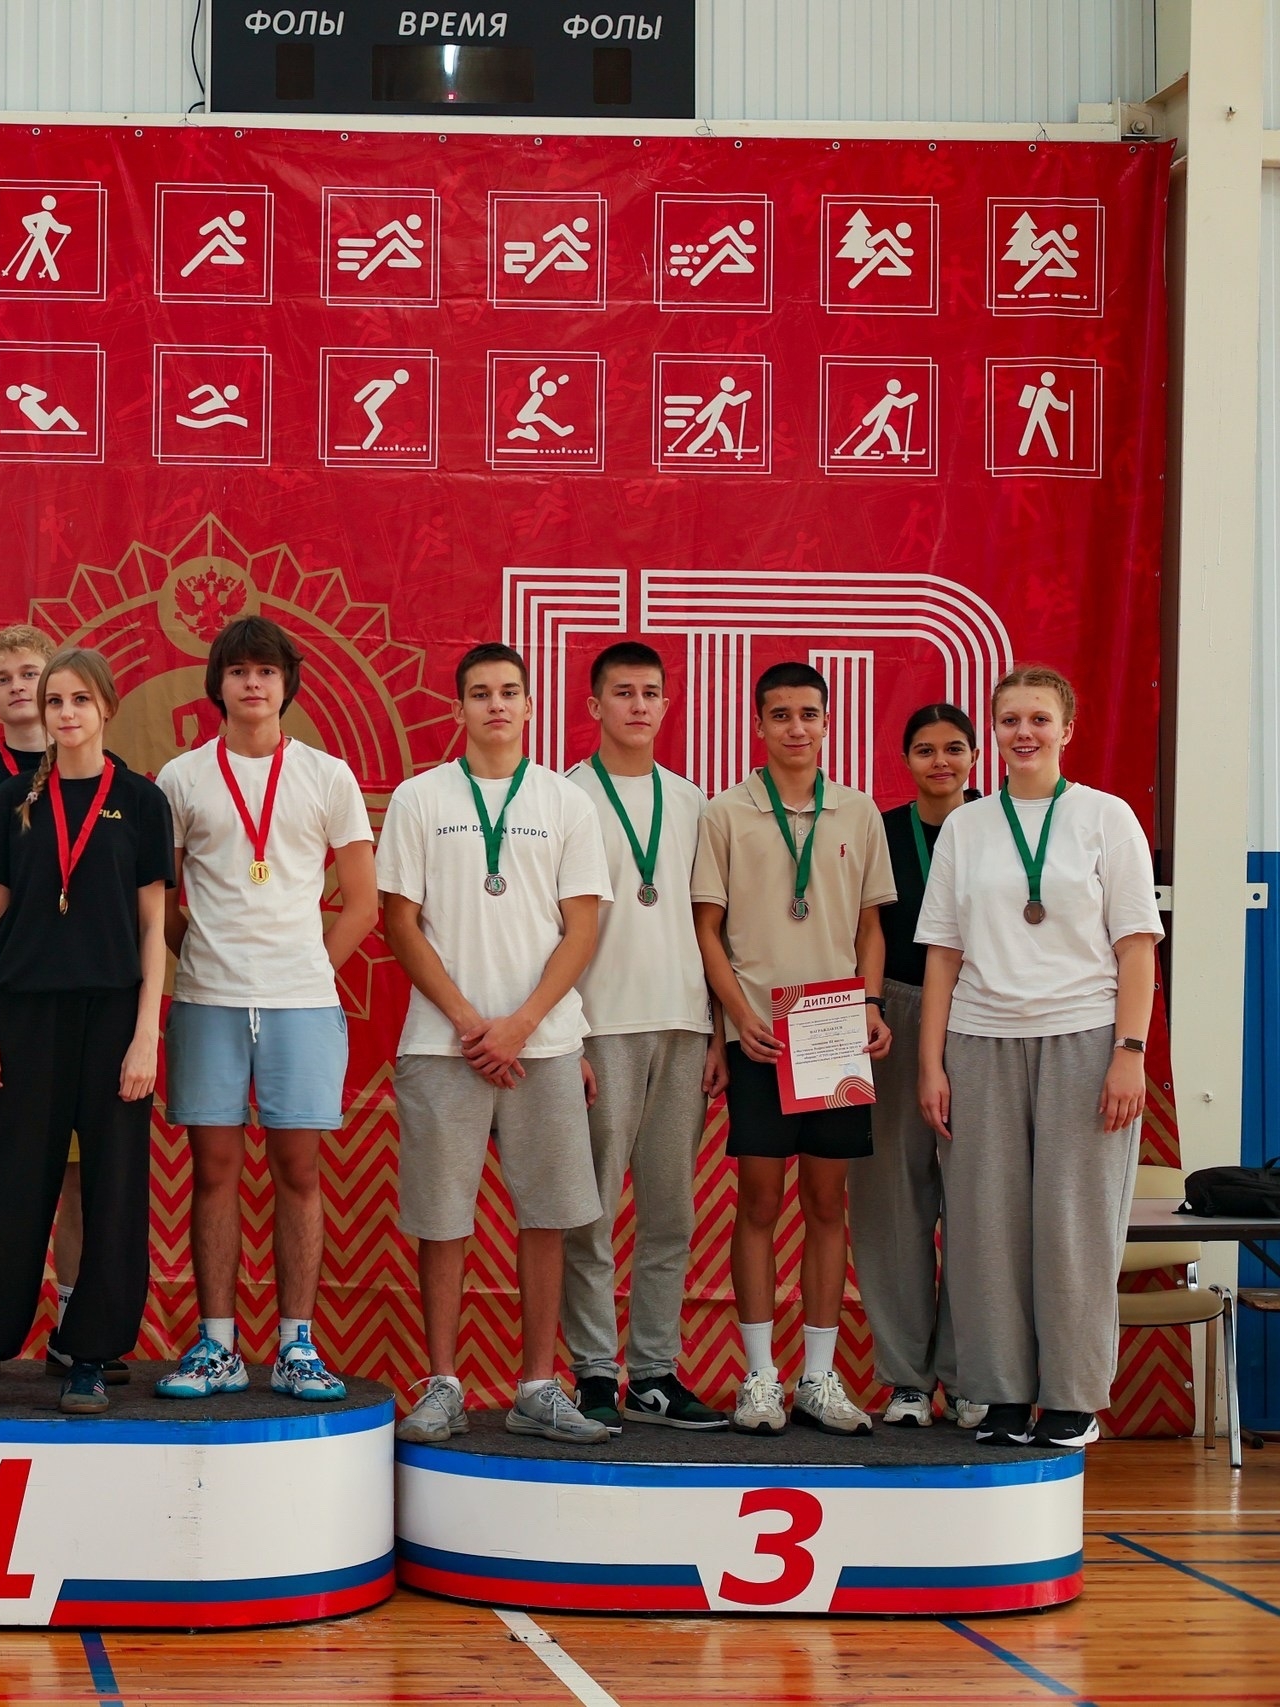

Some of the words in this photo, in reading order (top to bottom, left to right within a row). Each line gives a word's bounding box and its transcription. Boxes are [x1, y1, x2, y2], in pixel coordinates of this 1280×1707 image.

[244, 10, 346, 36] ФОЛЫ
[398, 12, 509, 38] ВРЕМЯ
[562, 14, 664, 40] ФОЛЫ
[511, 827, 549, 838] STUDIO
[803, 993, 851, 1009] ДИПЛОМ
[717, 1487, 824, 1606] 3
